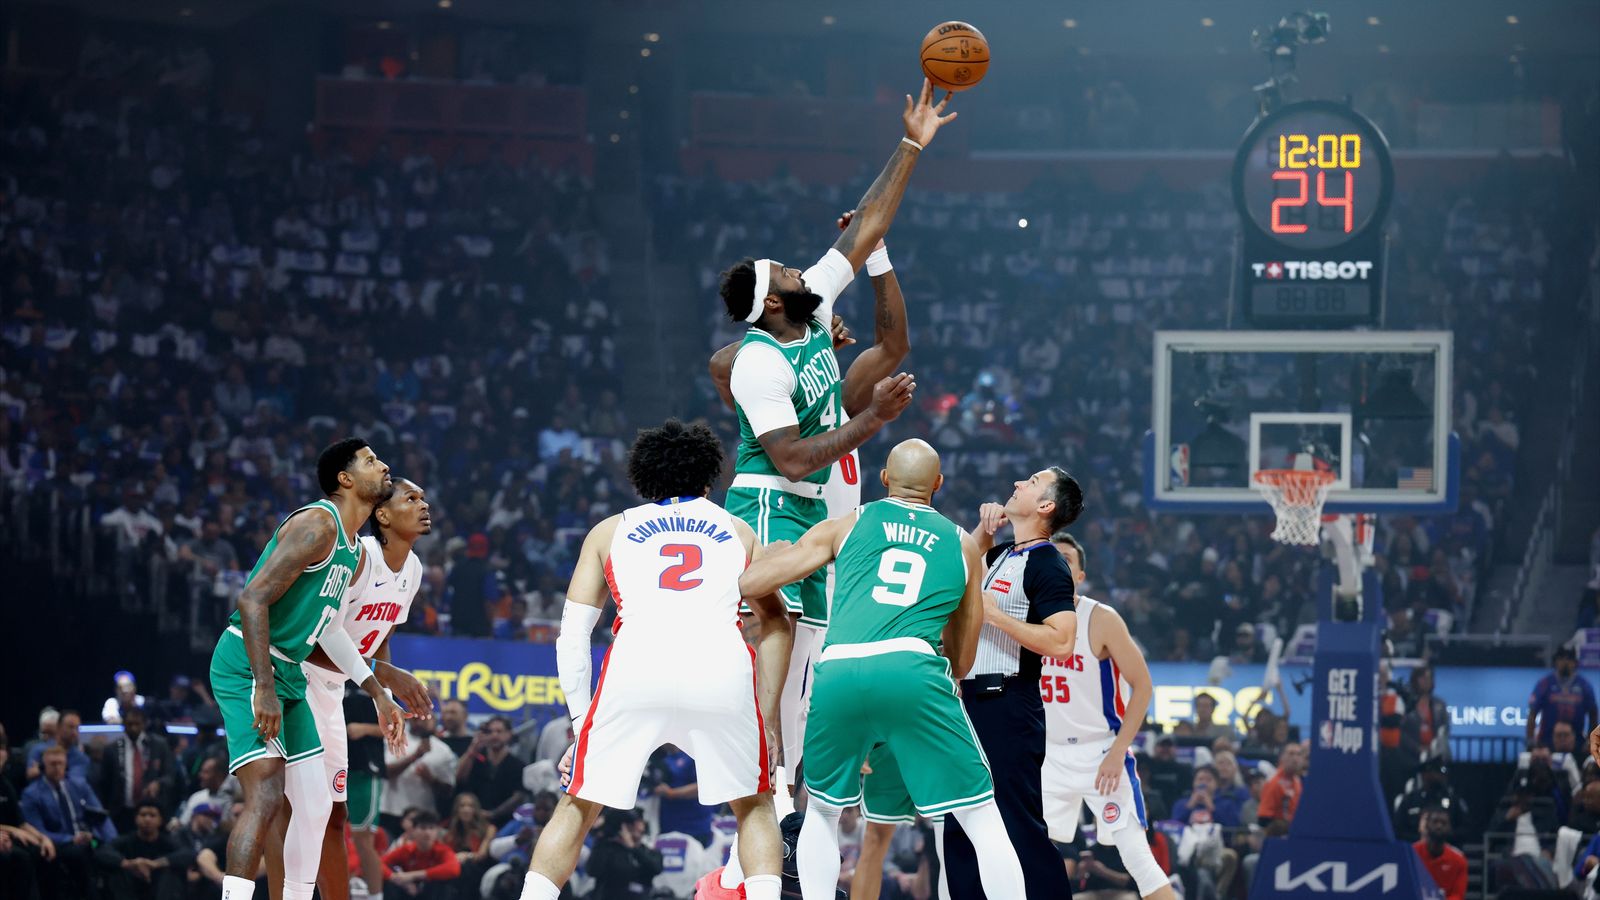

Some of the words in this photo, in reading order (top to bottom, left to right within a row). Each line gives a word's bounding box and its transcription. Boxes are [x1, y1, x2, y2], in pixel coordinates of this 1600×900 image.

[1279, 134, 1361, 169] 12:00
[1271, 171, 1353, 233] 24
[1284, 261, 1373, 279] TISSOT
[820, 392, 837, 432] 4
[627, 517, 733, 544] CUNNINGHAM
[882, 522, 940, 552] WHITE
[659, 543, 704, 592] 2
[871, 548, 927, 607] 9
[354, 602, 403, 623] PISTON
[358, 629, 380, 655] 9
[1040, 675, 1070, 704] 55
[1328, 669, 1358, 694] GET
[1327, 695, 1357, 721] THE
[1446, 706, 1497, 725] LINE
[1500, 706, 1541, 726] CL
[1333, 721, 1363, 754] App
[1274, 860, 1398, 894] KIA
